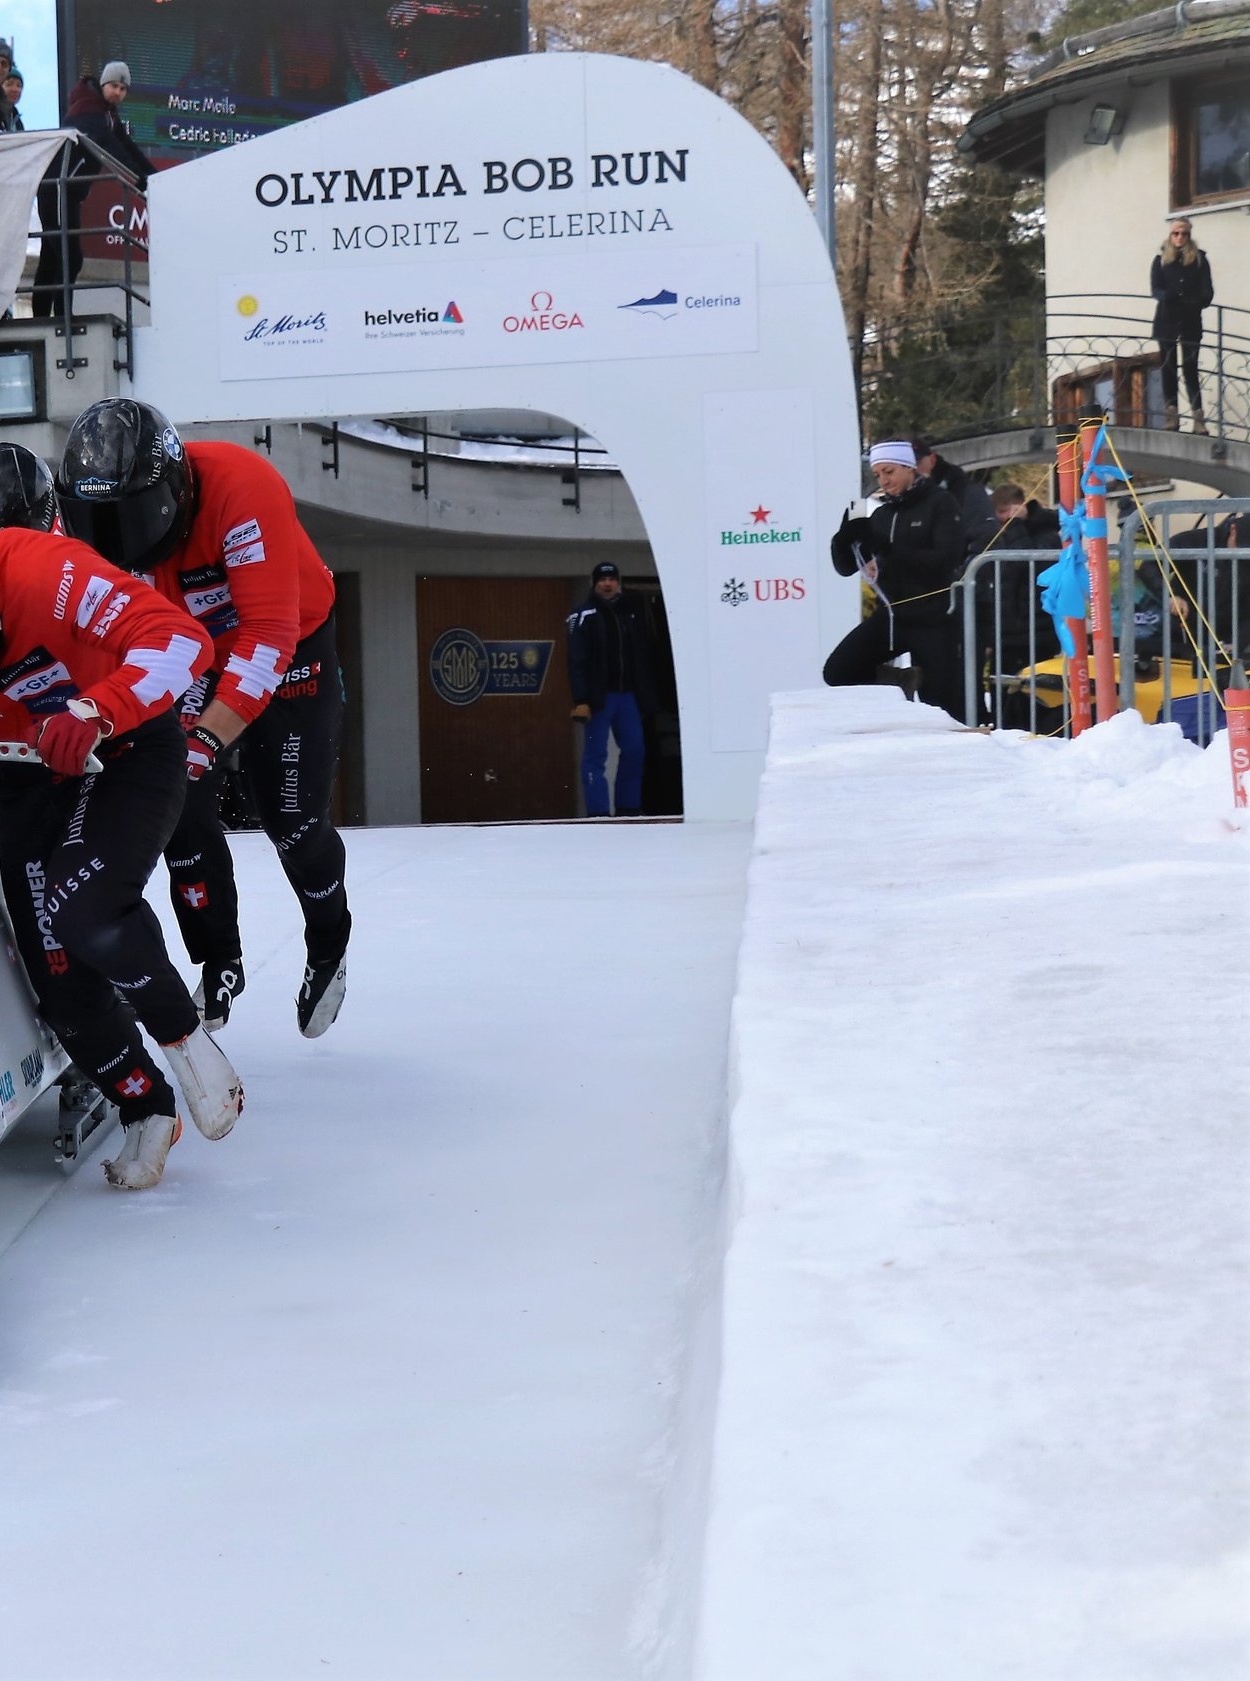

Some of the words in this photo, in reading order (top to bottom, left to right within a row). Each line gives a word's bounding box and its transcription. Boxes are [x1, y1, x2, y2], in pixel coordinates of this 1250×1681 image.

[255, 163, 467, 208] OLYMPIA
[483, 156, 574, 195] BOB
[591, 149, 690, 188] RUN
[273, 229, 317, 254] ST.
[332, 221, 460, 251] MORITZ
[503, 208, 674, 241] CELERINA
[684, 295, 741, 309] Celerina
[264, 311, 327, 337] Moritz
[364, 307, 440, 326] helvetia
[503, 313, 585, 333] OMEGA
[380, 329, 417, 339] Schweizer
[419, 328, 466, 338] Versicherung
[80, 484, 111, 492] BERNINA
[720, 529, 802, 546] Heineken
[753, 578, 806, 602] UBS
[491, 652, 519, 669] 125
[493, 672, 538, 687] YEARS
[195, 729, 219, 752] HIRZL
[281, 732, 301, 764] Bär
[281, 769, 301, 813] Julius
